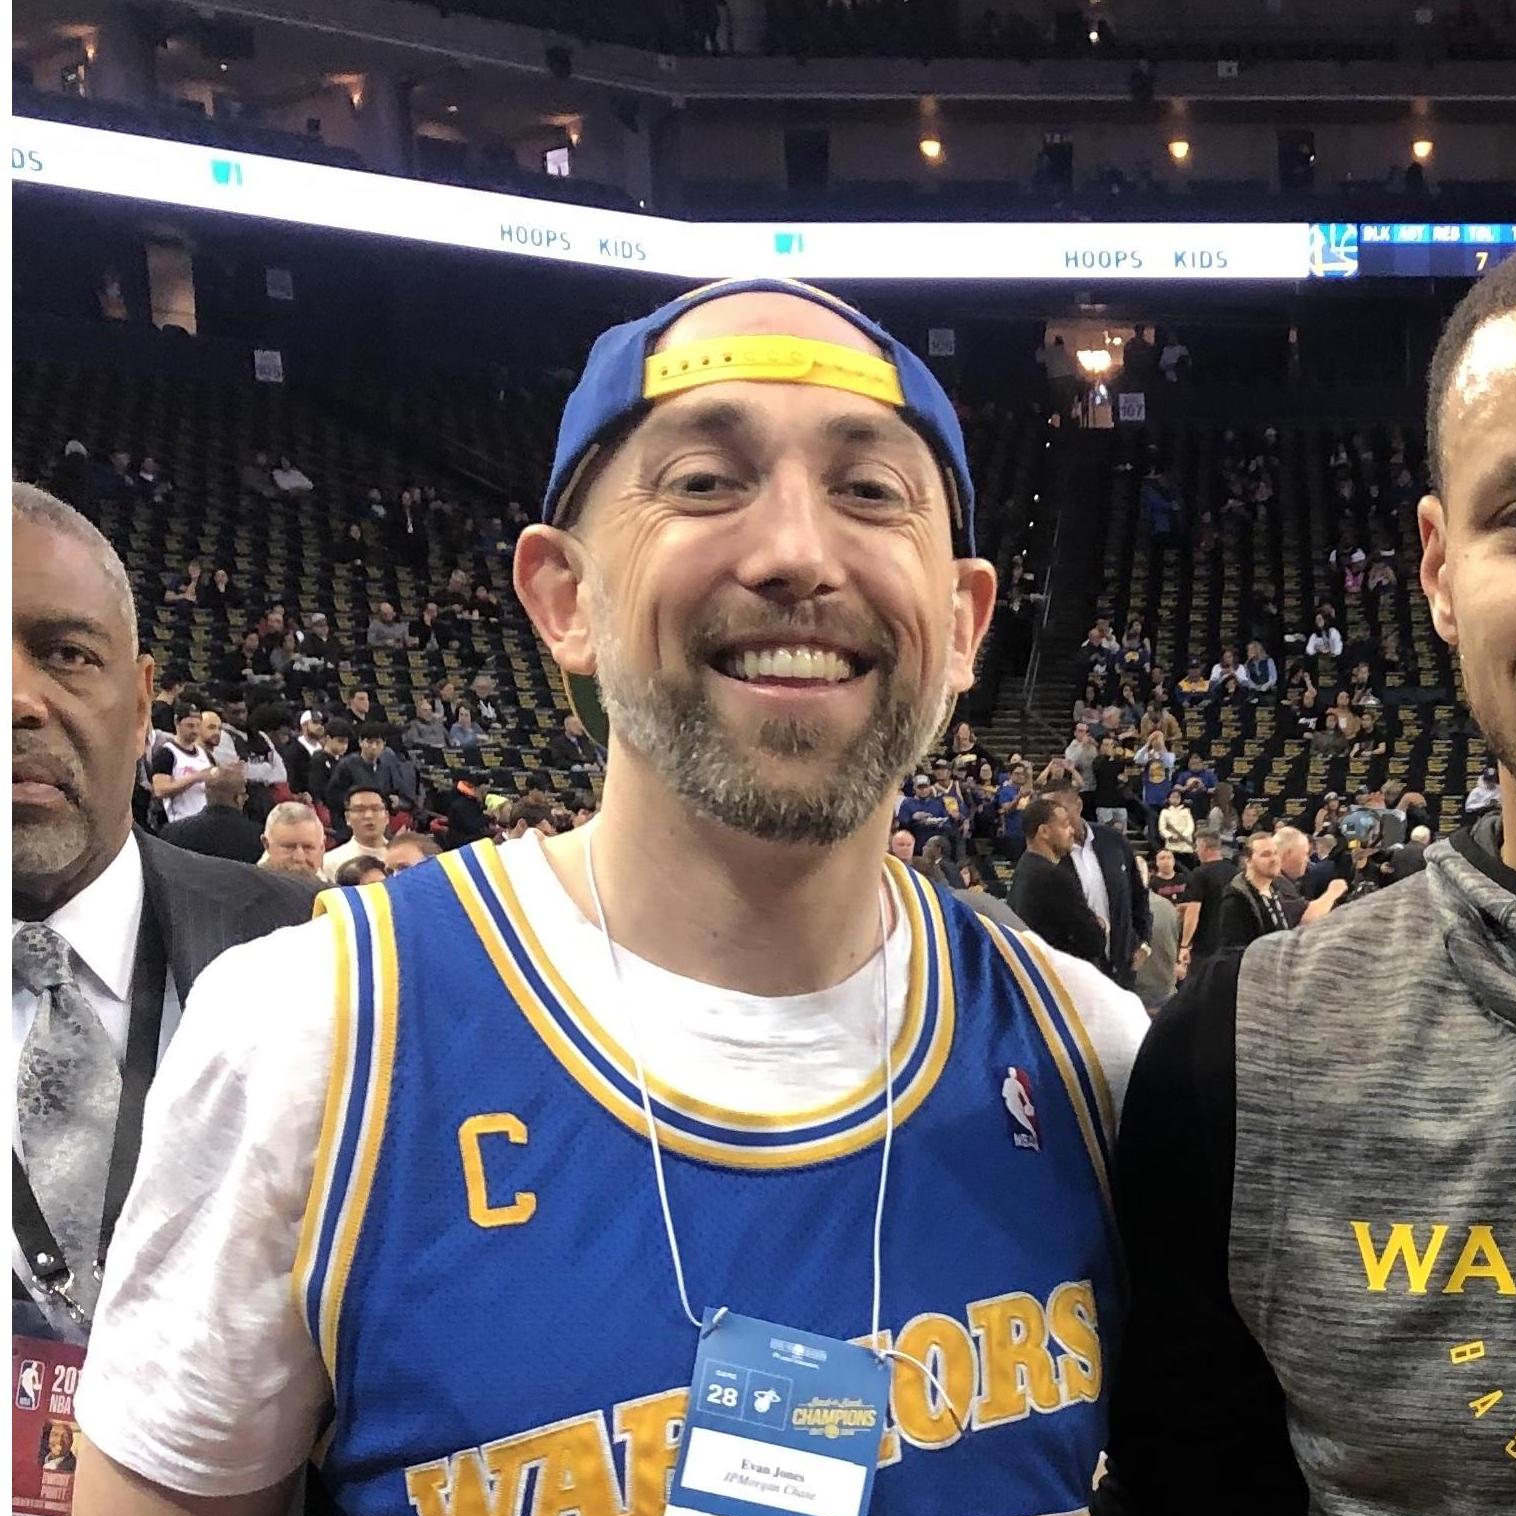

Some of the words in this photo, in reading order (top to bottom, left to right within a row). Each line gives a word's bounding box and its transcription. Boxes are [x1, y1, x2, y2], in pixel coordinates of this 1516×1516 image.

[500, 224, 571, 251] HOOPS
[599, 238, 646, 261] KIDS
[1065, 250, 1143, 269] HOOPS
[1174, 250, 1228, 269] KIDS
[1474, 251, 1489, 272] 7
[457, 1111, 536, 1228] C
[51, 1364, 81, 1394] 20
[49, 1394, 72, 1415] NBA
[706, 1383, 738, 1407] 28
[792, 1407, 877, 1427] CHAMPIONS
[723, 1471, 780, 1492] JPMorgan
[741, 1458, 771, 1475] Evan
[772, 1466, 804, 1483] Jones
